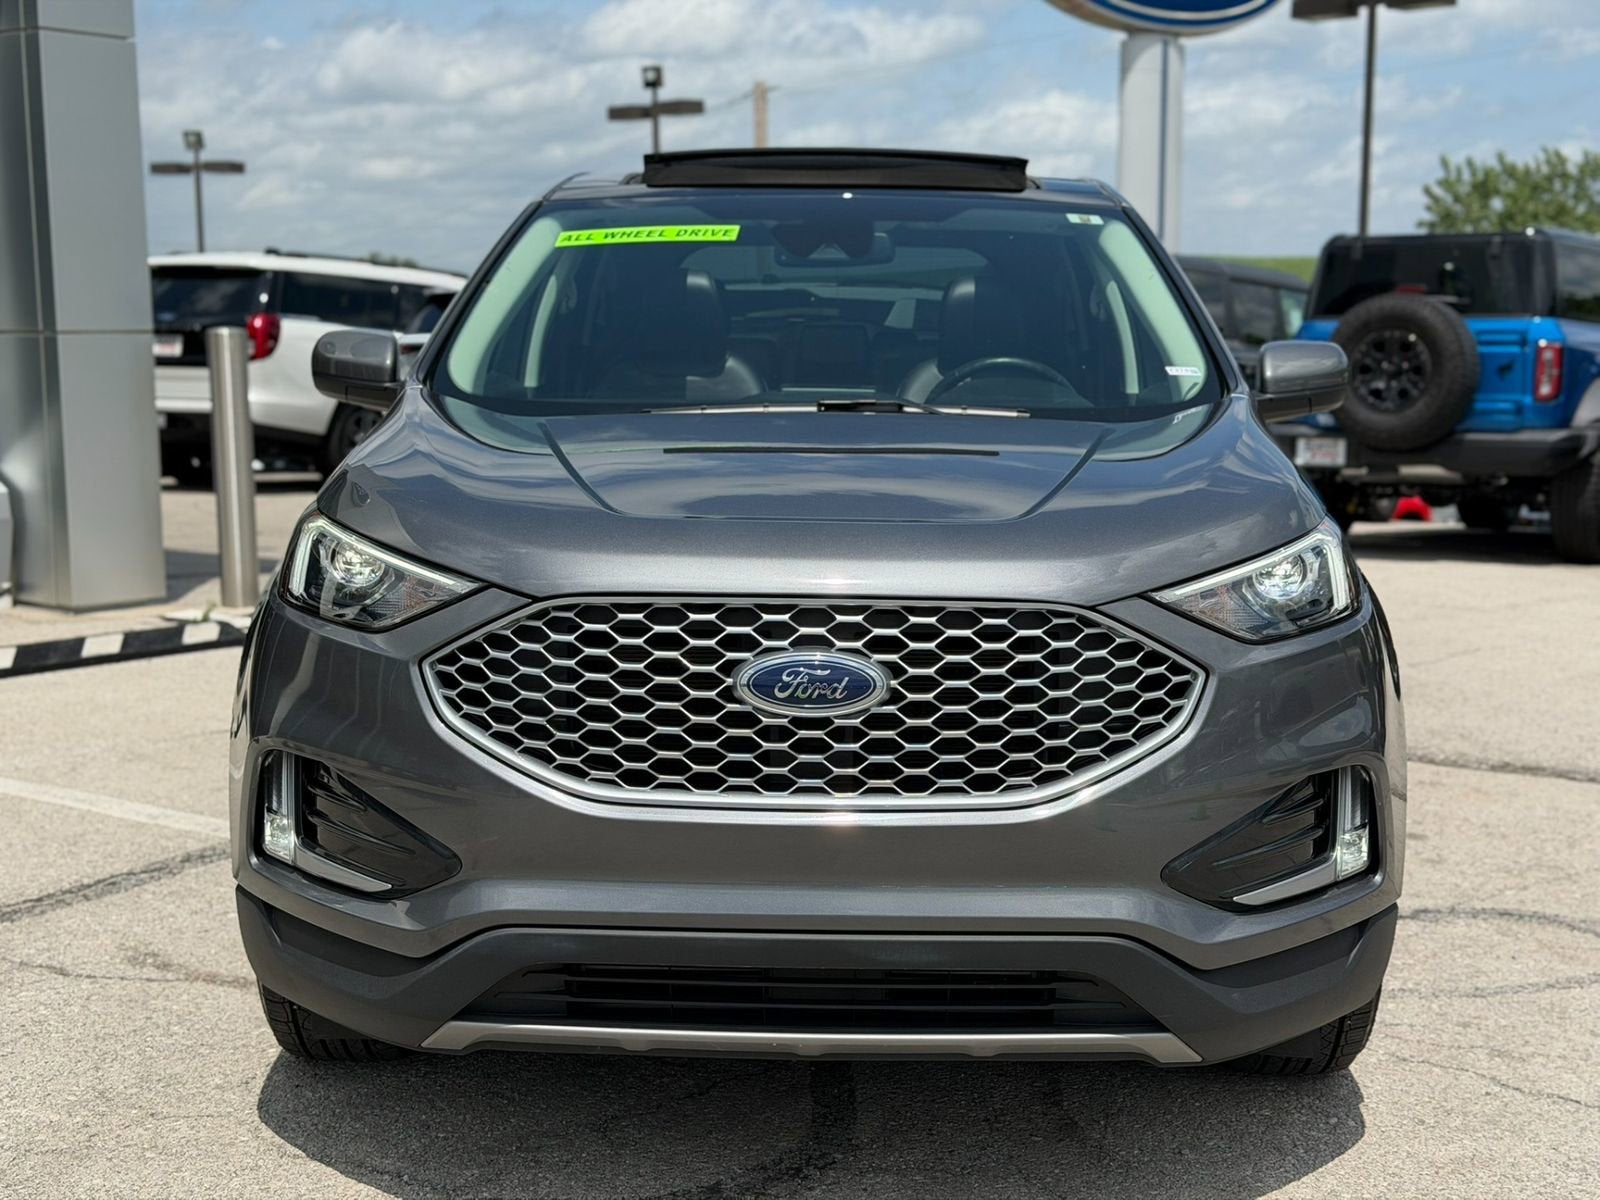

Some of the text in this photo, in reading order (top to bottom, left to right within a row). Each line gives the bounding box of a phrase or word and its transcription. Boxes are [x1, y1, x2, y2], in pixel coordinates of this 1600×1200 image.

[560, 228, 736, 242] ALL WHEEL DRIVE
[774, 667, 850, 699] Ford
